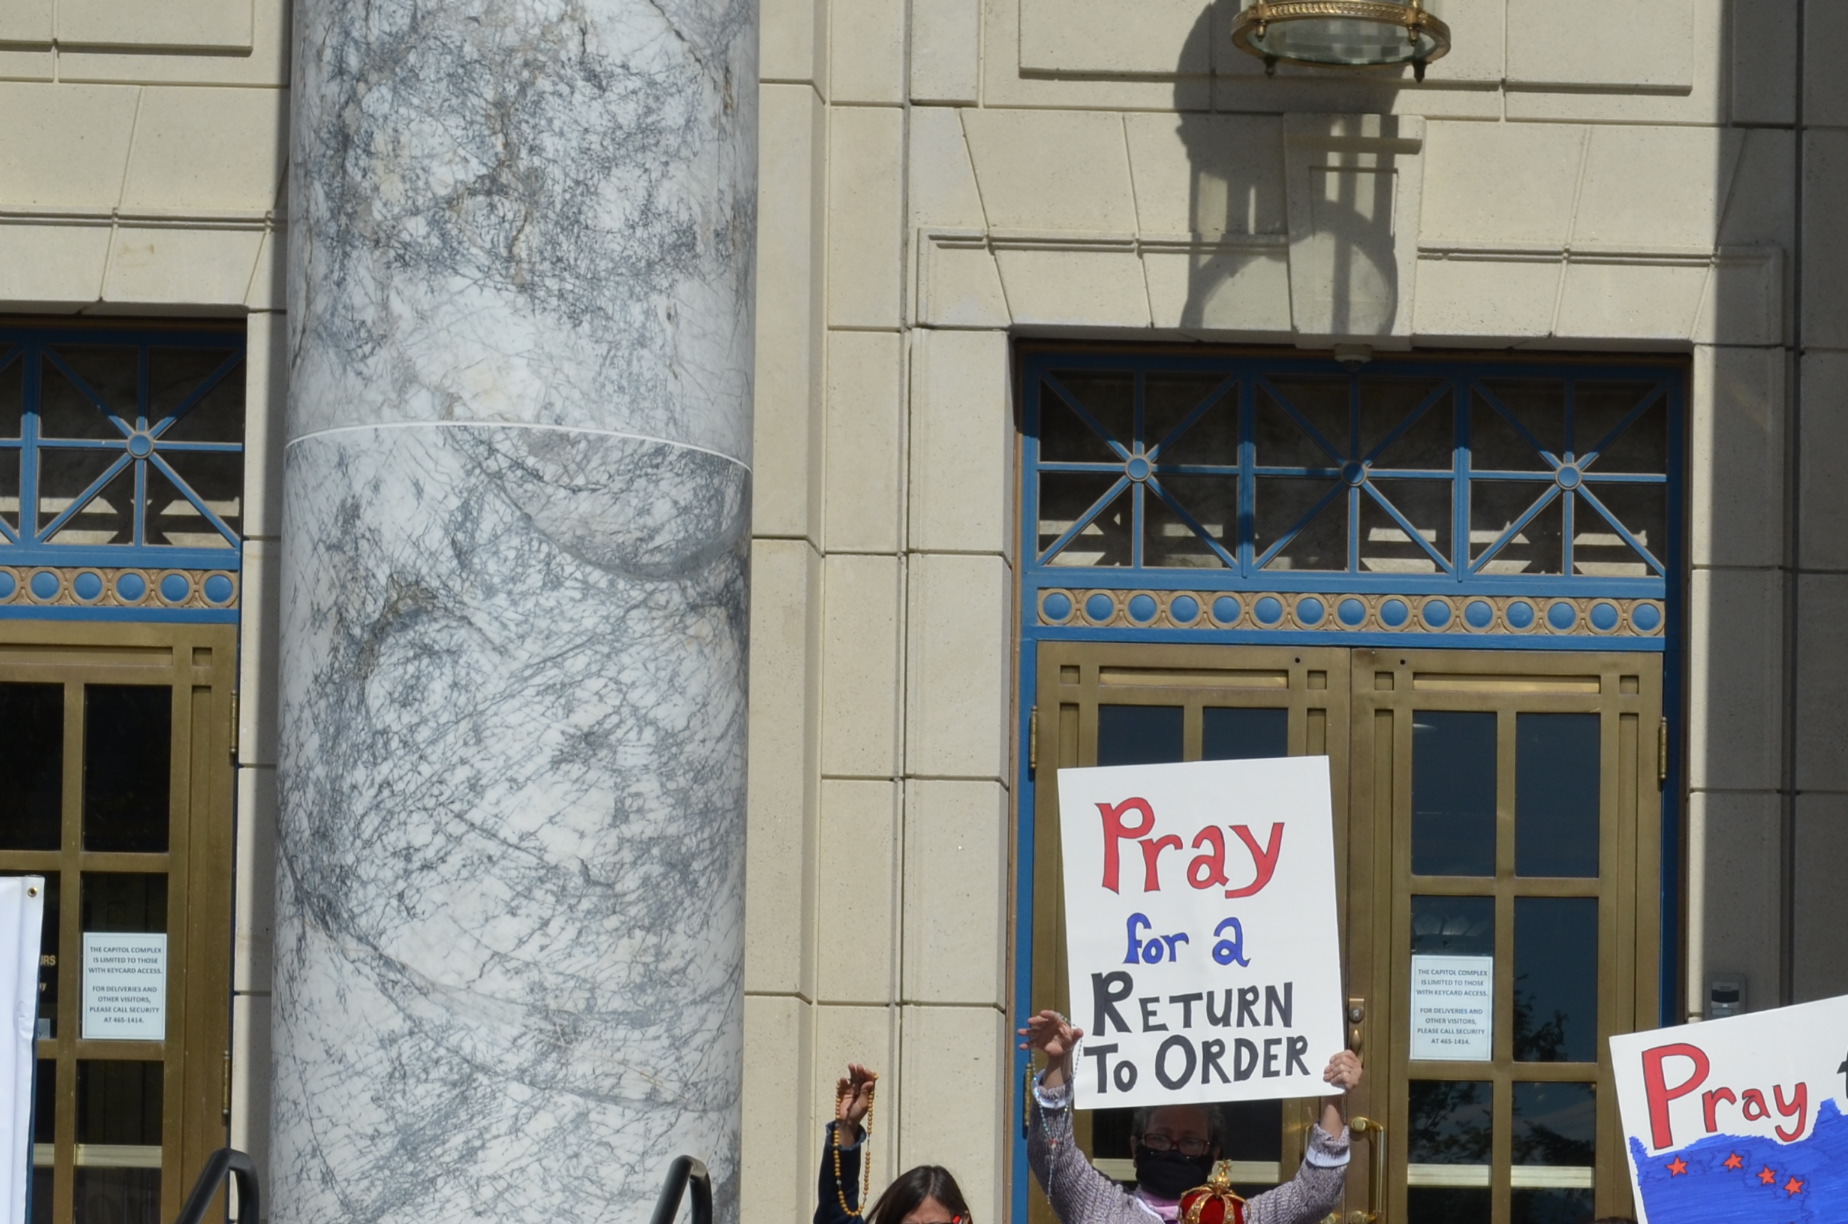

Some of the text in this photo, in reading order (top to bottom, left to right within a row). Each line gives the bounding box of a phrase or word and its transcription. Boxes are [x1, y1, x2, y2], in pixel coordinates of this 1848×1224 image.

[1095, 797, 1285, 899] Pray
[90, 946, 162, 954] THE CAPITOL COMPLEX
[1123, 913, 1250, 967] for a
[98, 996, 151, 1004] OTHER VISITORS,
[1091, 971, 1292, 1036] RETURN
[1416, 989, 1488, 997] WITH KEYCARD ACCESS.
[1420, 1007, 1483, 1015] FOR DELIVERIES AND
[1155, 1035, 1310, 1090] ORDER
[1641, 1043, 1809, 1150] Pray
